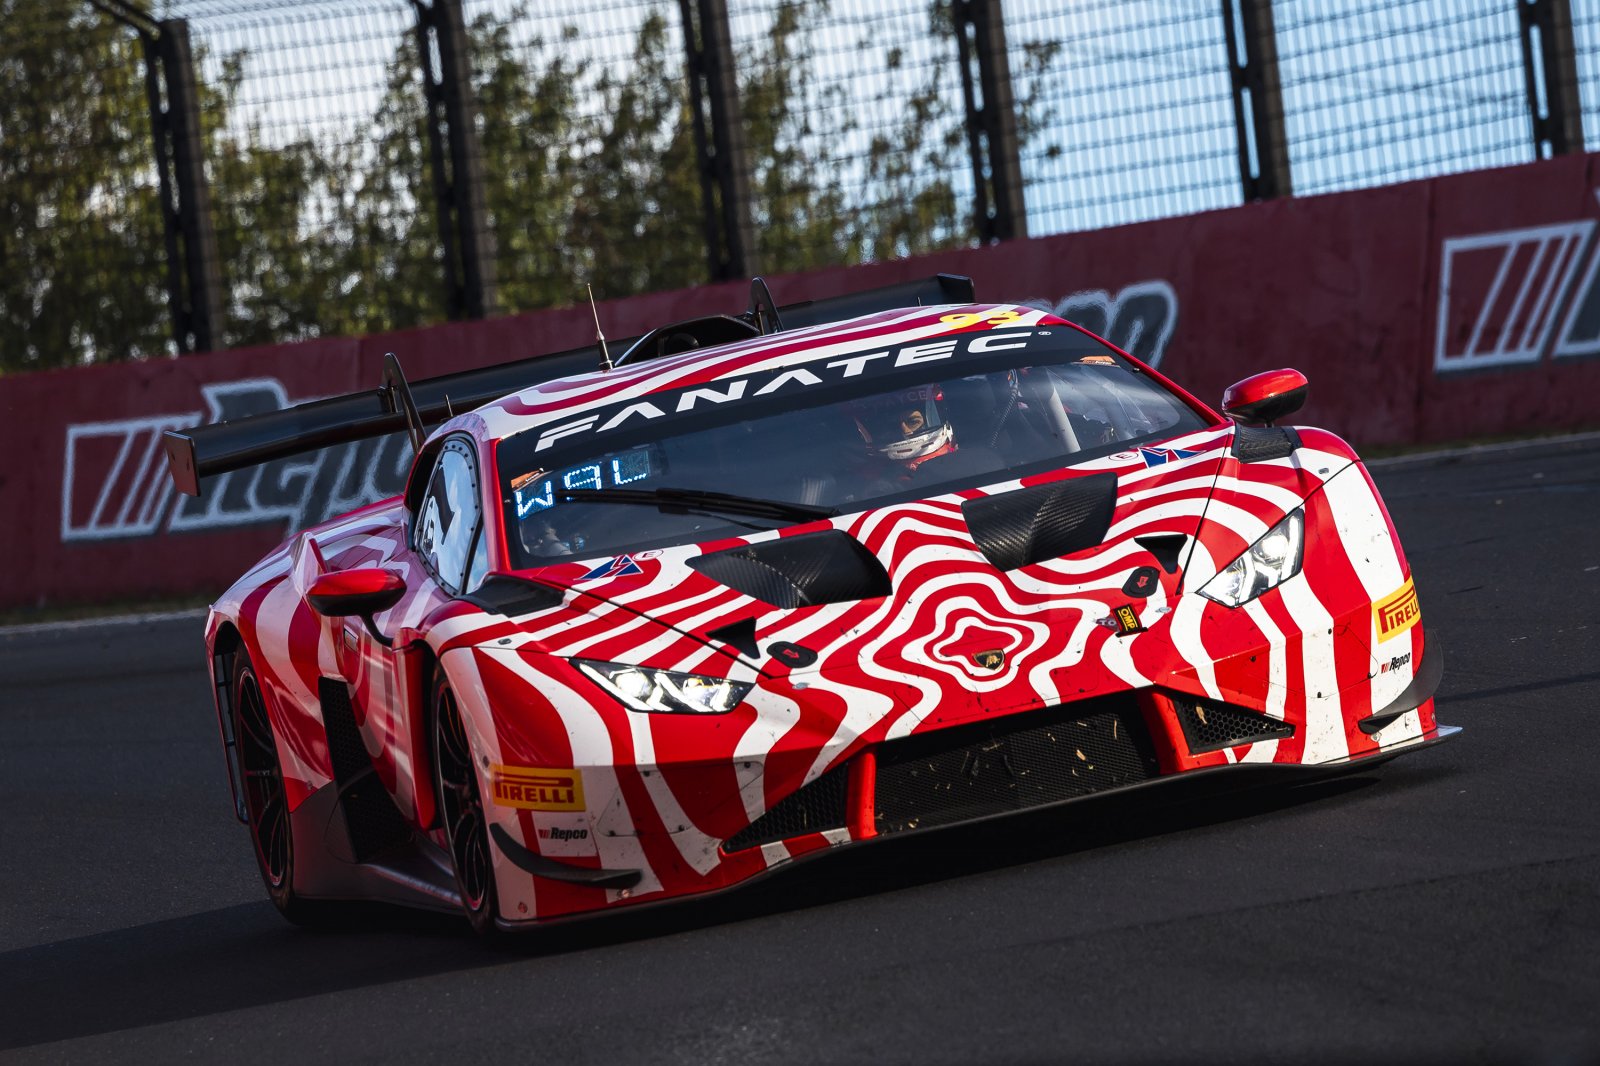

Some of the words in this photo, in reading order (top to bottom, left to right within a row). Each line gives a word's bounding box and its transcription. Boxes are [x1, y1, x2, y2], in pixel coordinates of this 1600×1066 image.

[939, 311, 1024, 329] 93
[535, 332, 1031, 452] FANATEC
[1120, 608, 1136, 629] OMP
[1389, 652, 1411, 673] Repco
[494, 772, 576, 804] PIRELLI
[550, 827, 588, 842] Repco
